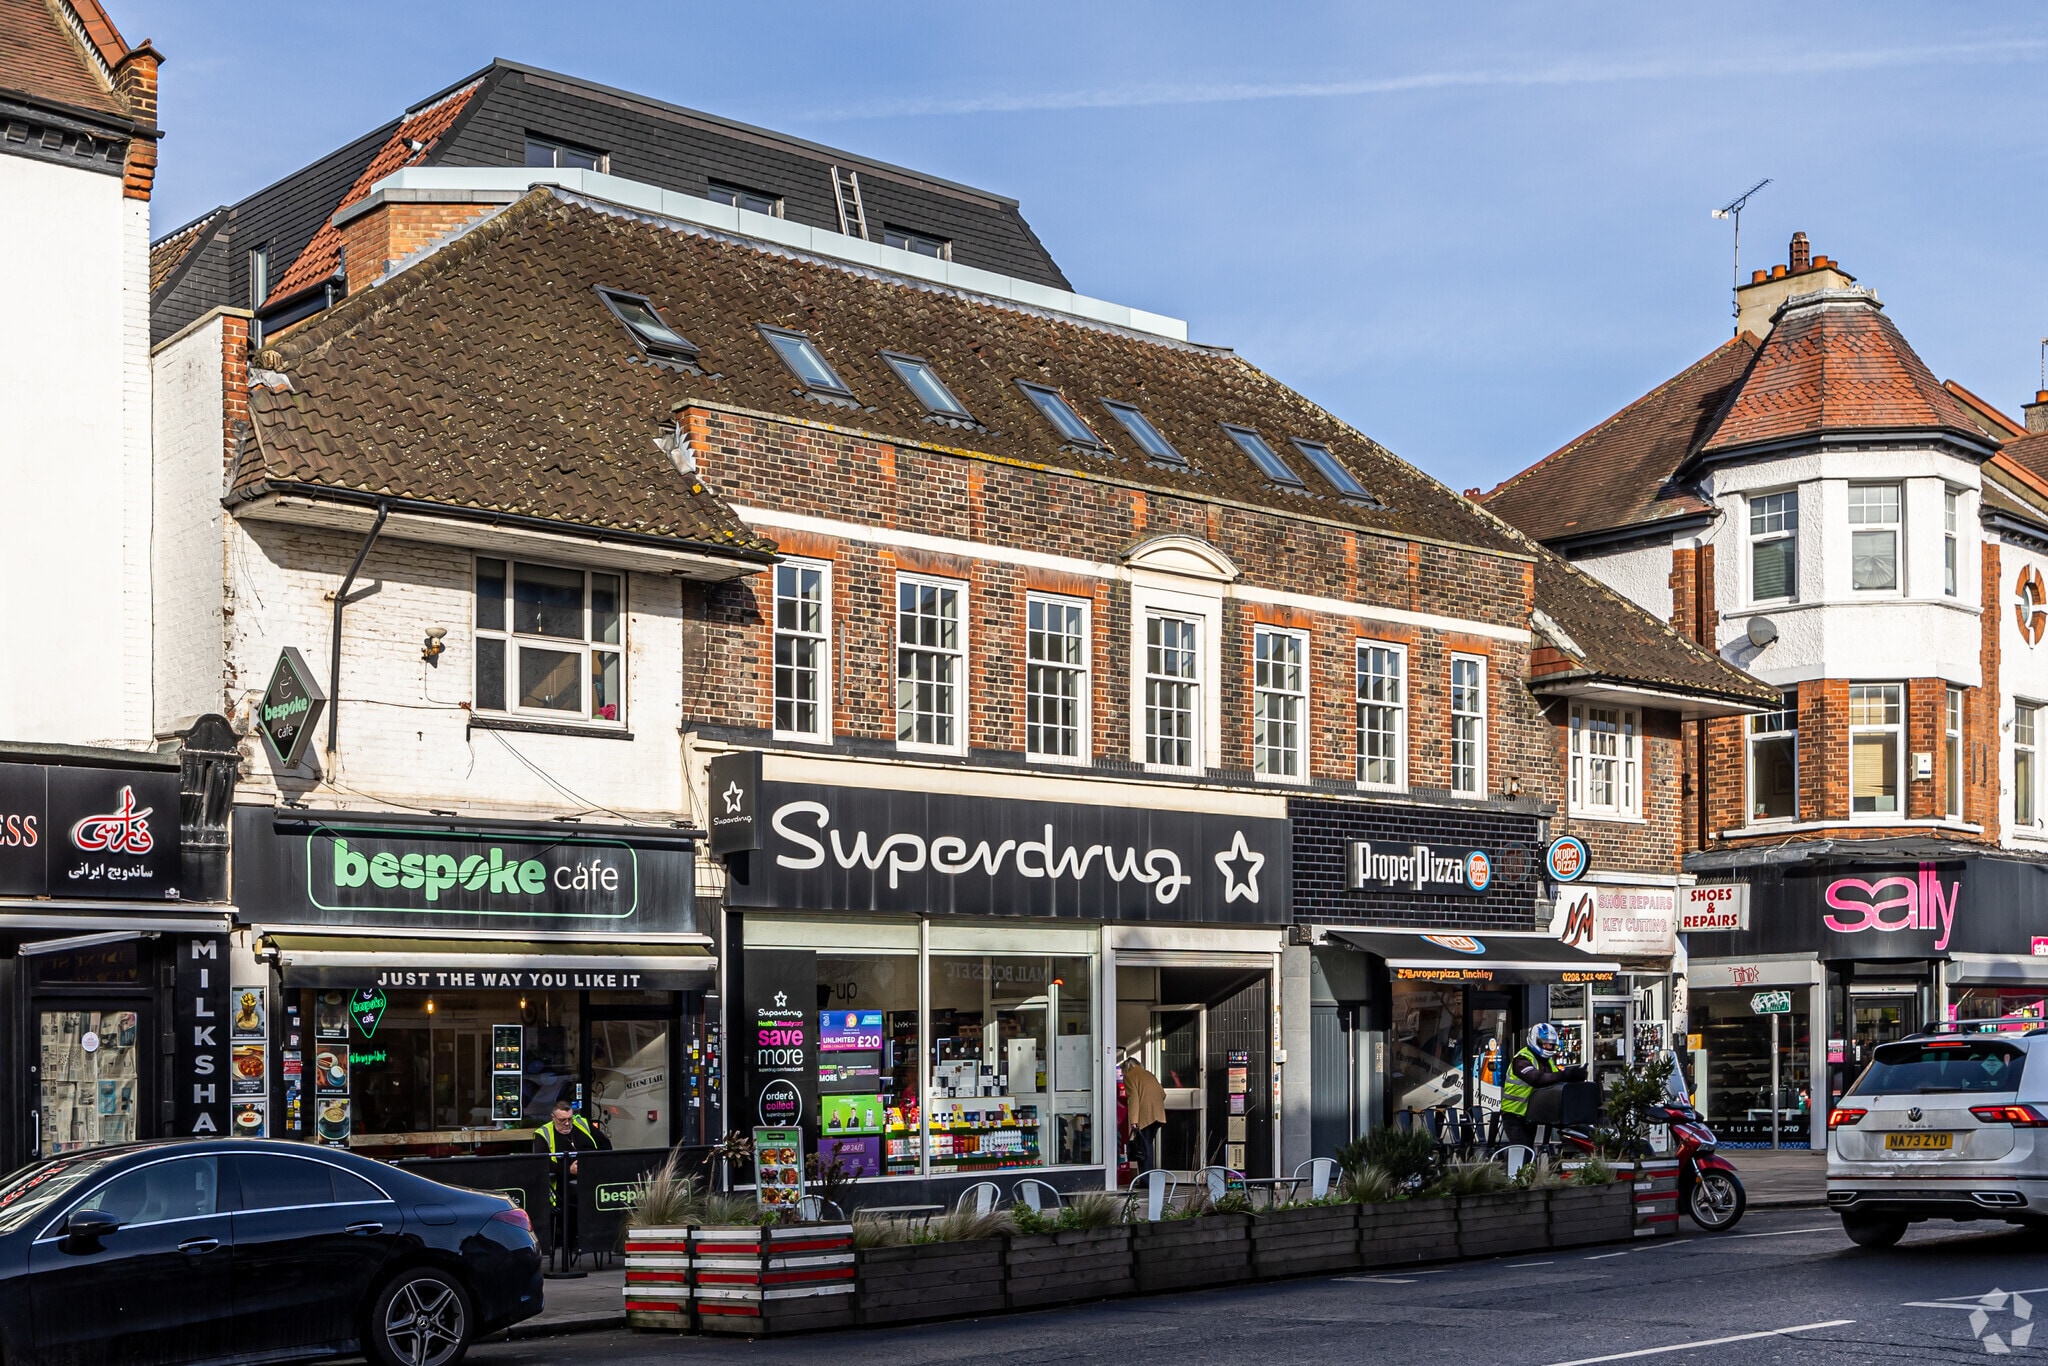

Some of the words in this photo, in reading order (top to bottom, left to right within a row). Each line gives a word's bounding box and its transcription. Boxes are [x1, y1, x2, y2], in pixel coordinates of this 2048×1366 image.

[264, 696, 308, 721] bespoke
[713, 815, 752, 826] Superdrug
[0, 814, 38, 847] SS
[772, 801, 1191, 904] Superdrug
[1555, 847, 1578, 860] proper
[334, 838, 547, 901] bespoke
[1557, 860, 1577, 872] pizza
[1600, 894, 1628, 909] SHOE
[1630, 895, 1673, 911] REPAIRS
[1690, 888, 1732, 902] SHOES
[1706, 901, 1716, 914] &
[1823, 861, 1958, 950] sally
[1602, 917, 1625, 932] KEY
[1626, 918, 1667, 933] CUTTING
[1683, 913, 1737, 928] REPAIRS
[378, 972, 430, 987] JUST
[436, 972, 476, 987] THE
[482, 973, 523, 987] WAY
[529, 973, 567, 988] YOU
[574, 974, 616, 988] LIKE
[623, 974, 640, 988] IT
[758, 1008, 803, 1018] Superdrug
[191, 939, 218, 1139] MILKSHA
[758, 1029, 804, 1046] save
[822, 1035, 856, 1044] UNLIMITED
[857, 1035, 880, 1048] £20
[758, 1048, 804, 1065] more
[819, 1074, 838, 1082] MORE
[766, 1100, 795, 1111] collect
[1889, 1134, 1921, 1147] NA73
[1922, 1134, 1948, 1147] ZYD
